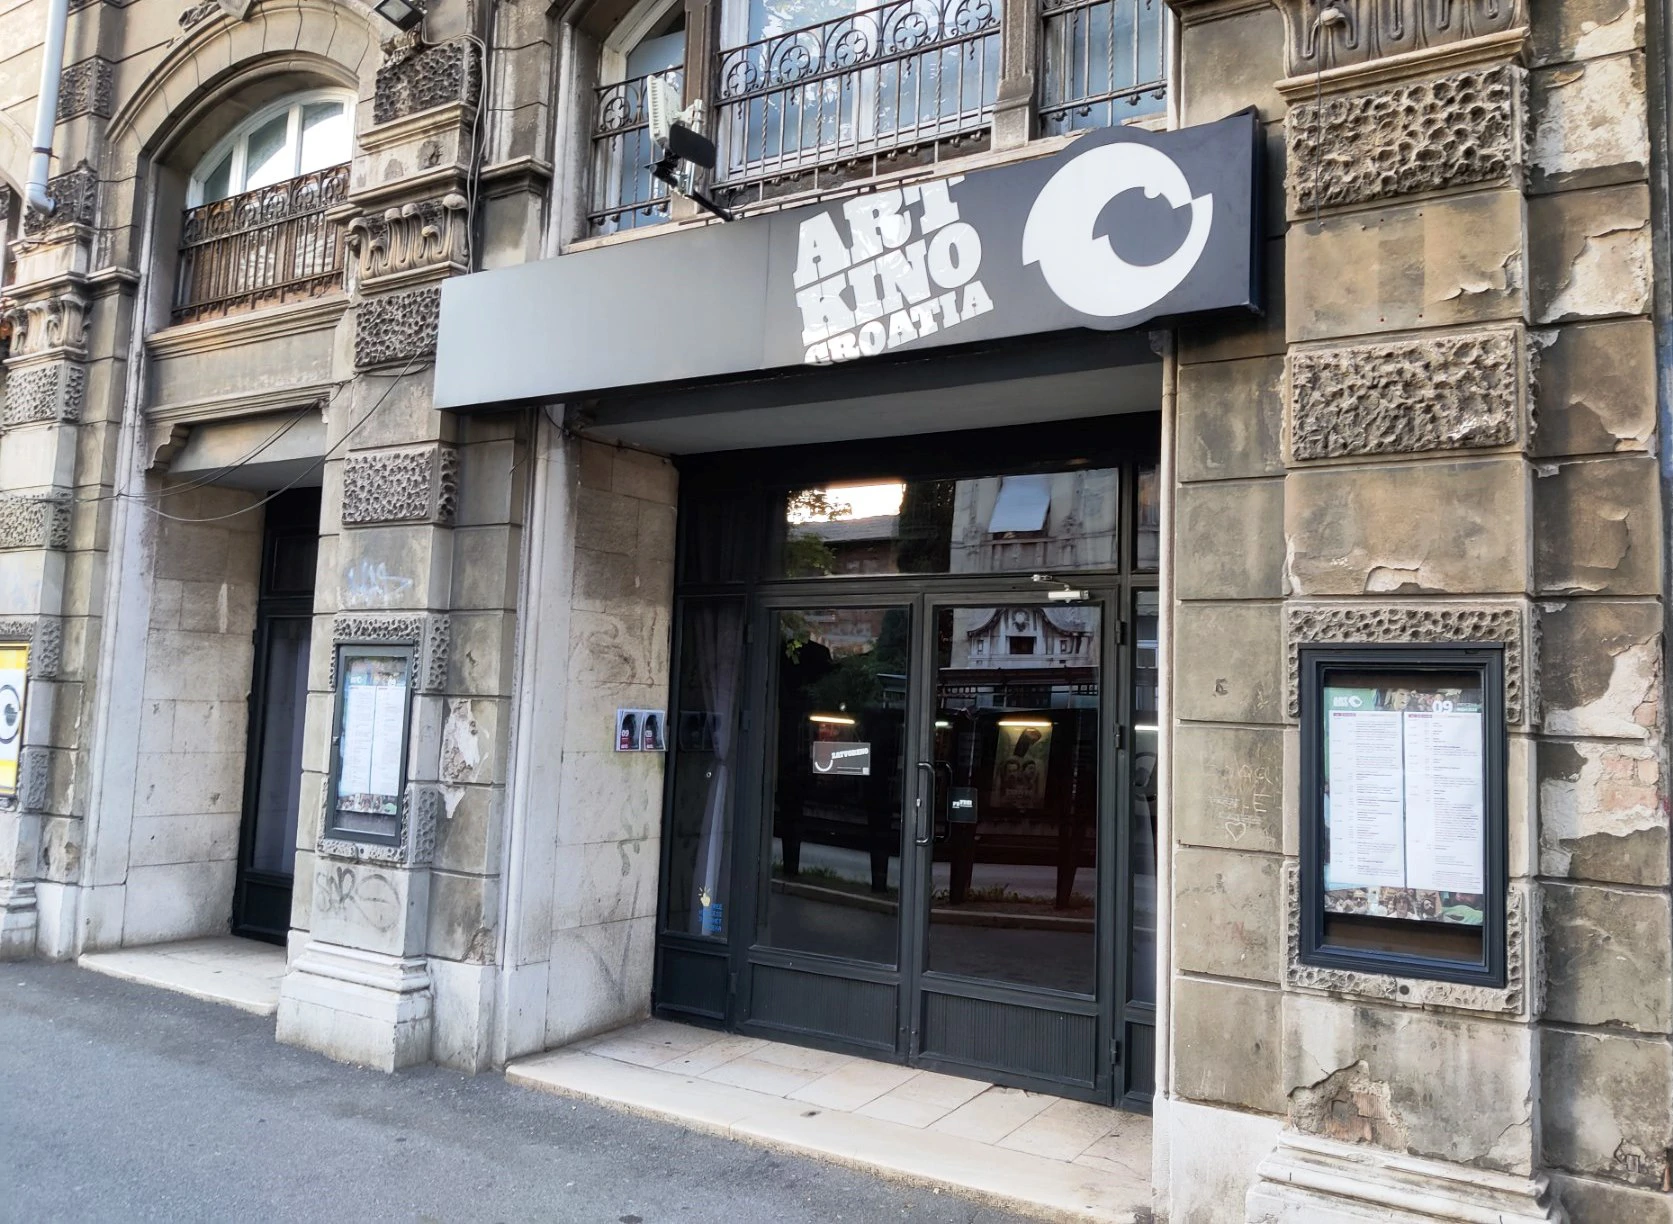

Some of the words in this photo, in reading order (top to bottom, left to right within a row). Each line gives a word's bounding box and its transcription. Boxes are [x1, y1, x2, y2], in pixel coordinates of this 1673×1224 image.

[793, 175, 966, 288] ART
[796, 222, 981, 346] KINO
[804, 281, 994, 366] CROATIA
[1432, 700, 1454, 713] 09
